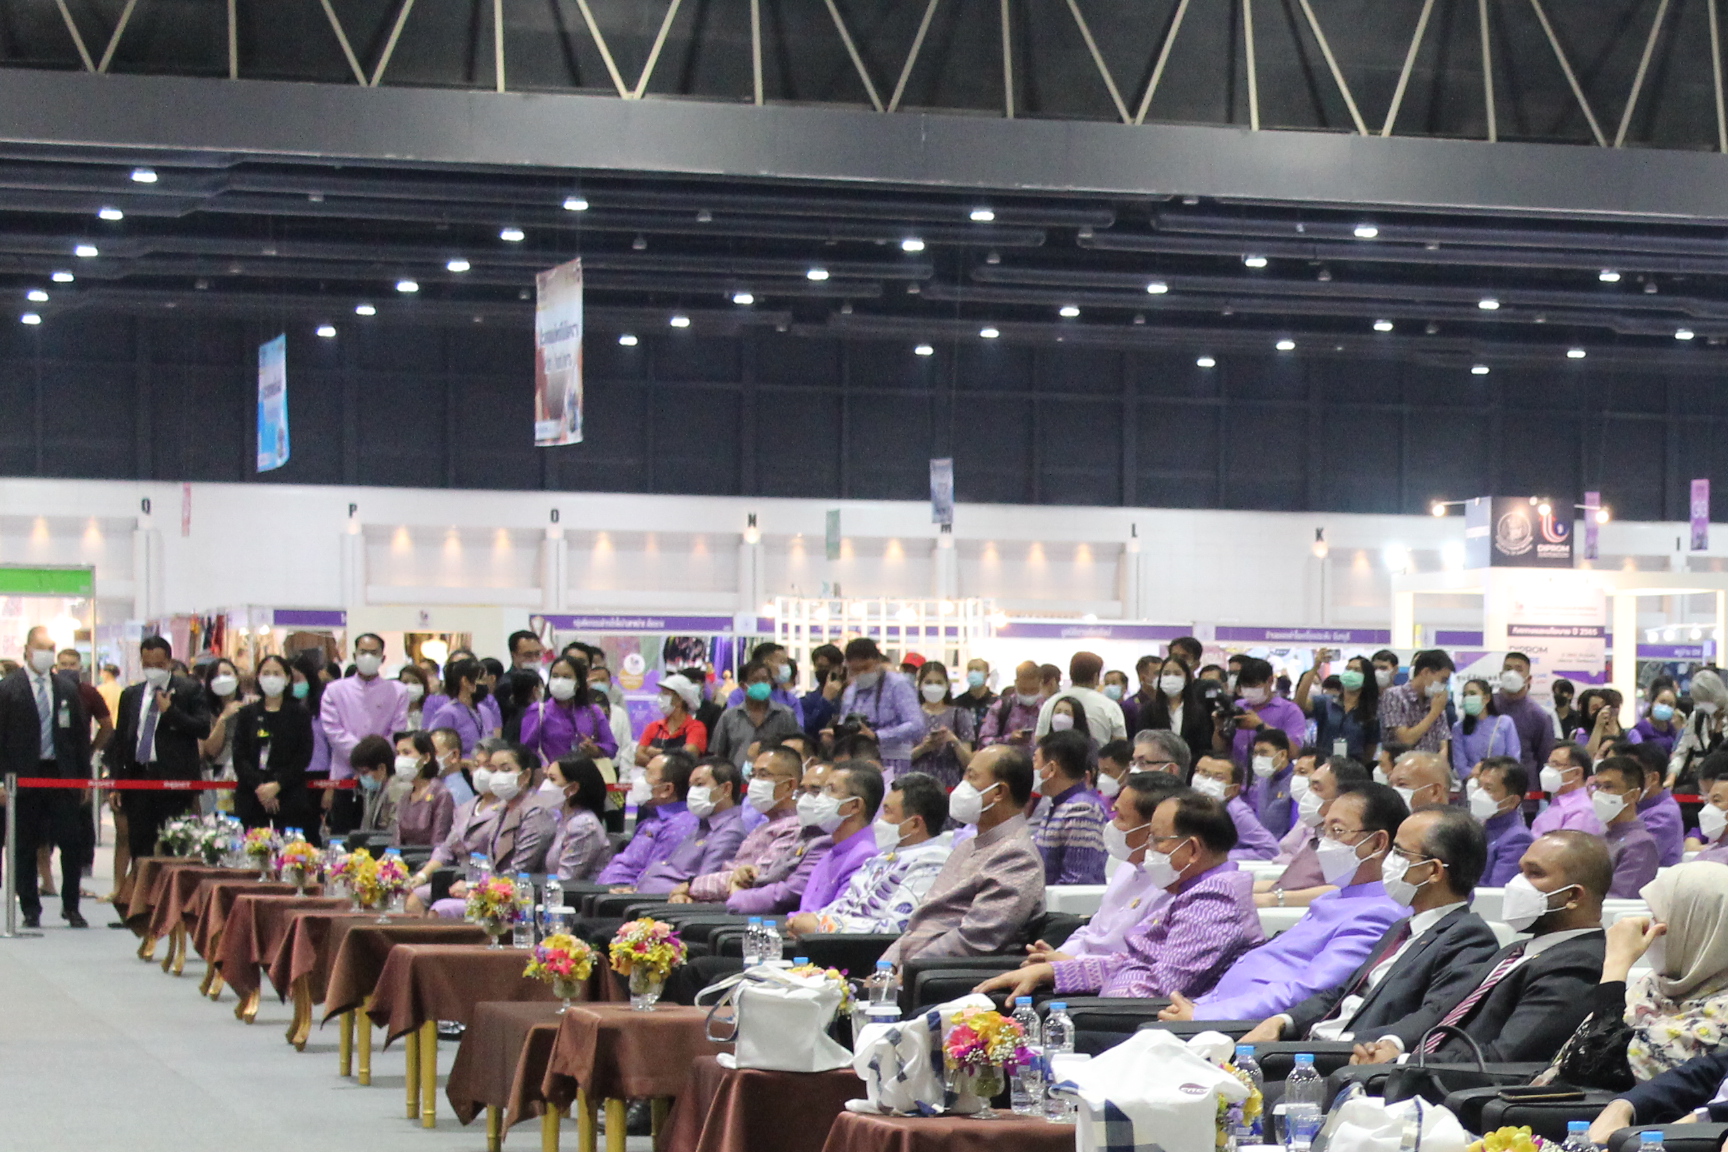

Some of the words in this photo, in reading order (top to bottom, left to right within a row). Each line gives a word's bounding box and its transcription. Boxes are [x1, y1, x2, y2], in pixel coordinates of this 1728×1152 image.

[141, 498, 151, 514] Q
[348, 502, 358, 518] P
[747, 513, 757, 528] N
[1131, 523, 1138, 538] L
[1315, 527, 1325, 542] K
